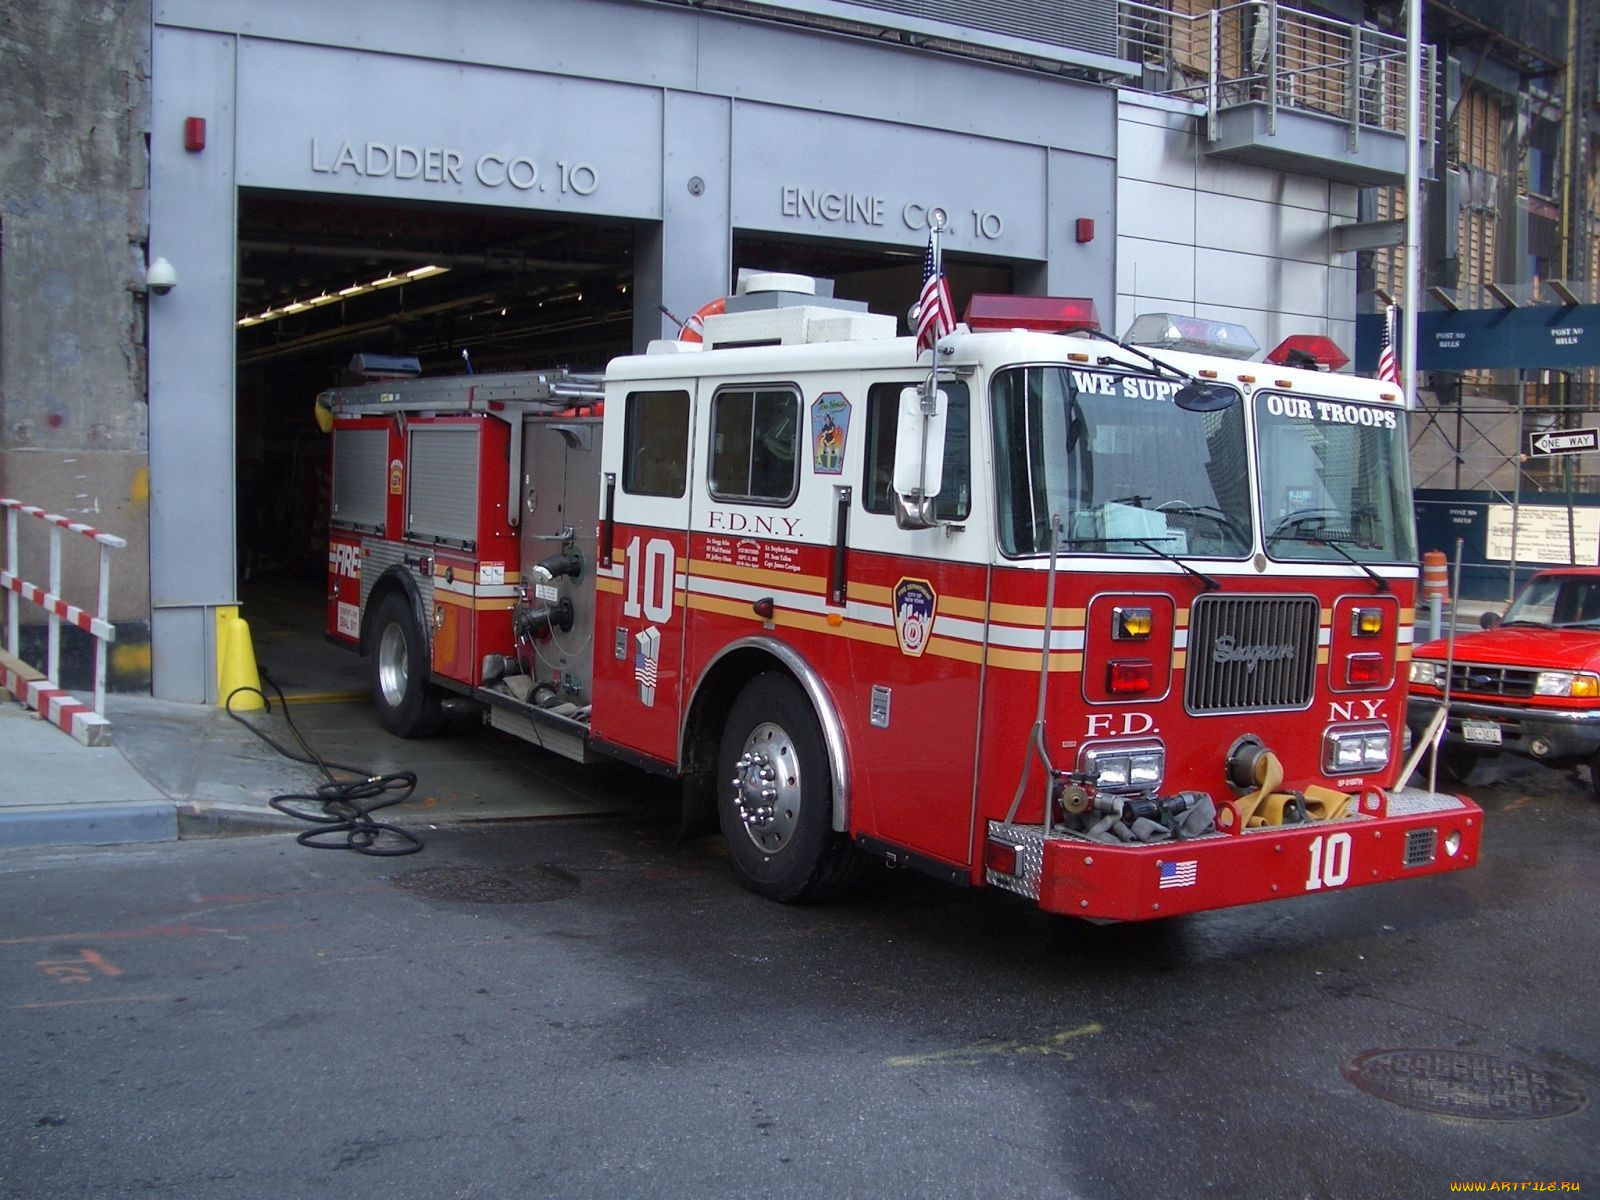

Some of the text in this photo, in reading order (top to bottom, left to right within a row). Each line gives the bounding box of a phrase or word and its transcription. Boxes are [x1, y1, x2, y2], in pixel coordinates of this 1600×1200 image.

[310, 137, 600, 195] LADDER CO. 10
[781, 185, 1004, 240] ENGINE CO. 10
[1551, 327, 1584, 336] POST NO
[1555, 337, 1578, 345] BILLS
[1072, 371, 1185, 402] WE SUPP
[1267, 395, 1397, 429] OUR TROOPS
[1541, 436, 1590, 448] ONE WAY
[708, 511, 804, 537] F.D.N.Y.
[335, 543, 360, 579] FIRE
[623, 535, 675, 624] 10
[1085, 712, 1160, 737] F.D.
[1328, 699, 1388, 722] N.Y.
[1305, 831, 1352, 890] 10
